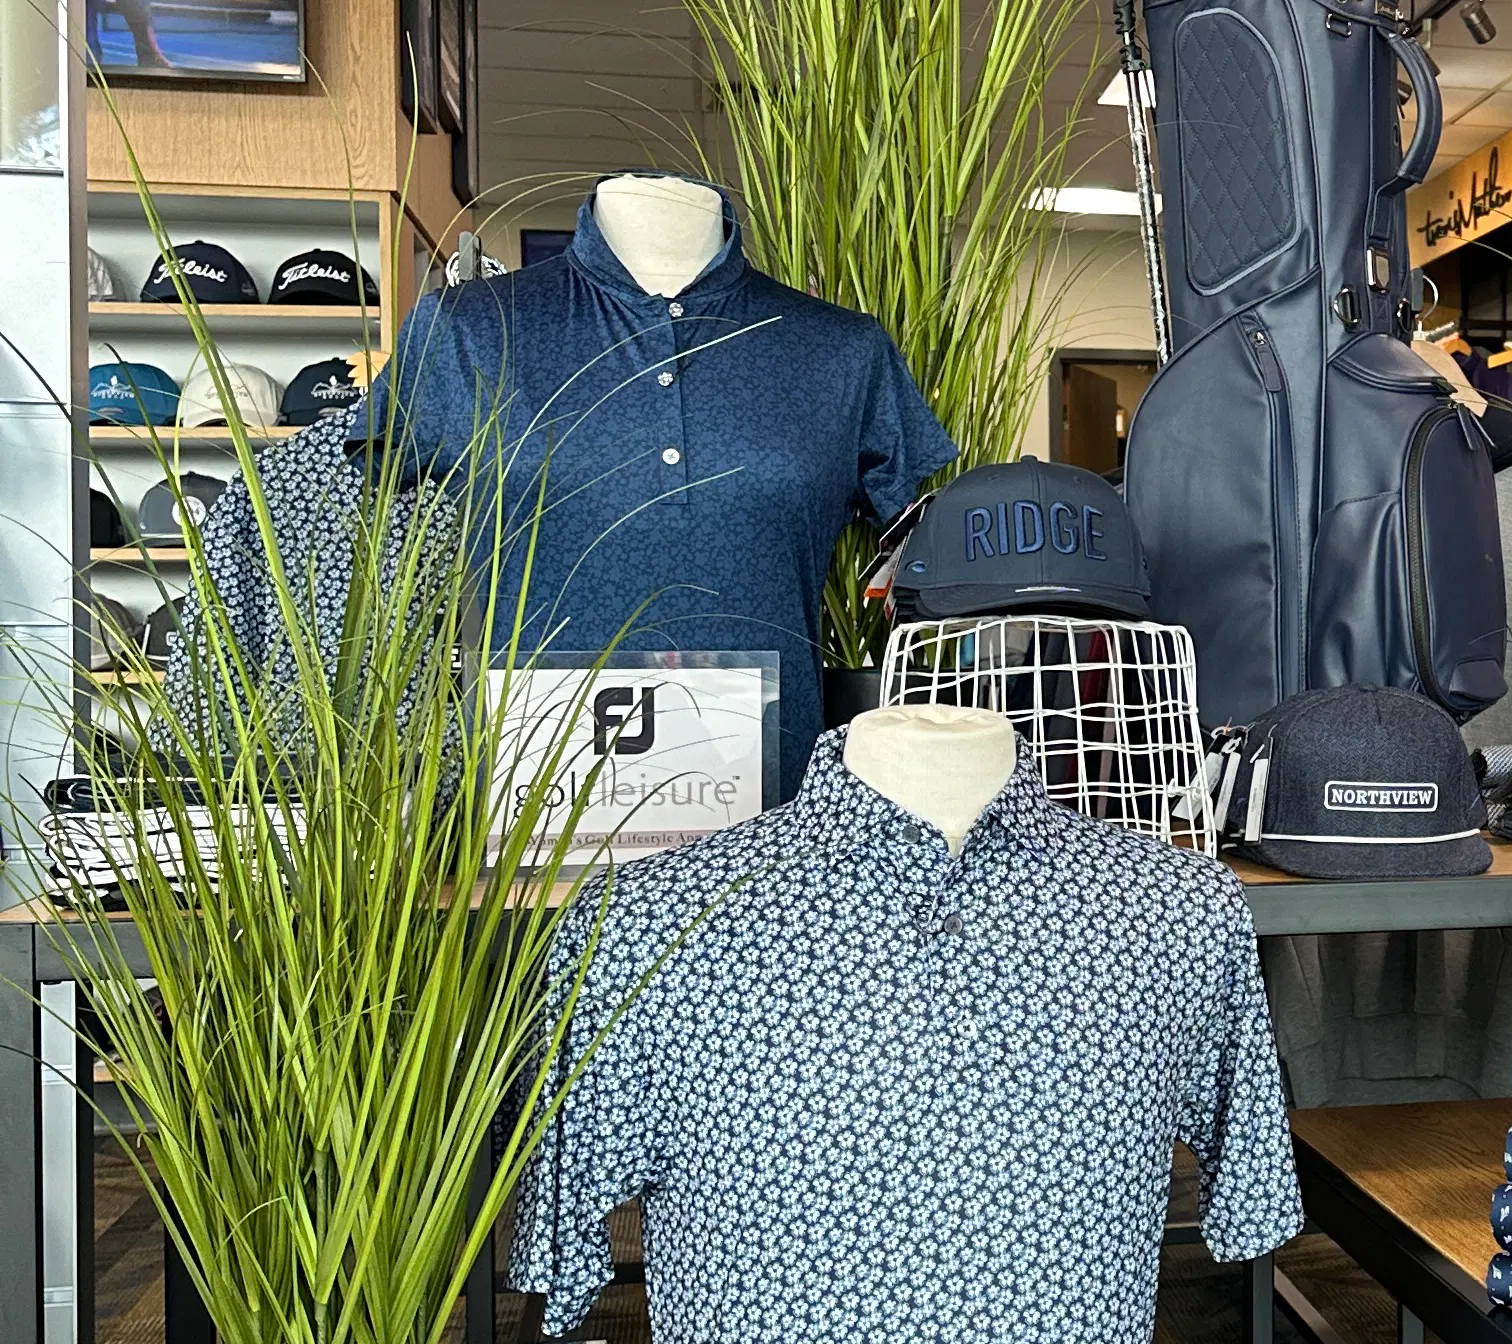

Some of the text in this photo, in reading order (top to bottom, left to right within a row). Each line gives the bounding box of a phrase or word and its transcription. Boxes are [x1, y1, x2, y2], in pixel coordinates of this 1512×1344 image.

[964, 500, 1107, 561] RIDGE
[593, 687, 655, 755] FJ
[1331, 788, 1433, 805] NORTHVIEW
[617, 833, 674, 846] Lifestyle
